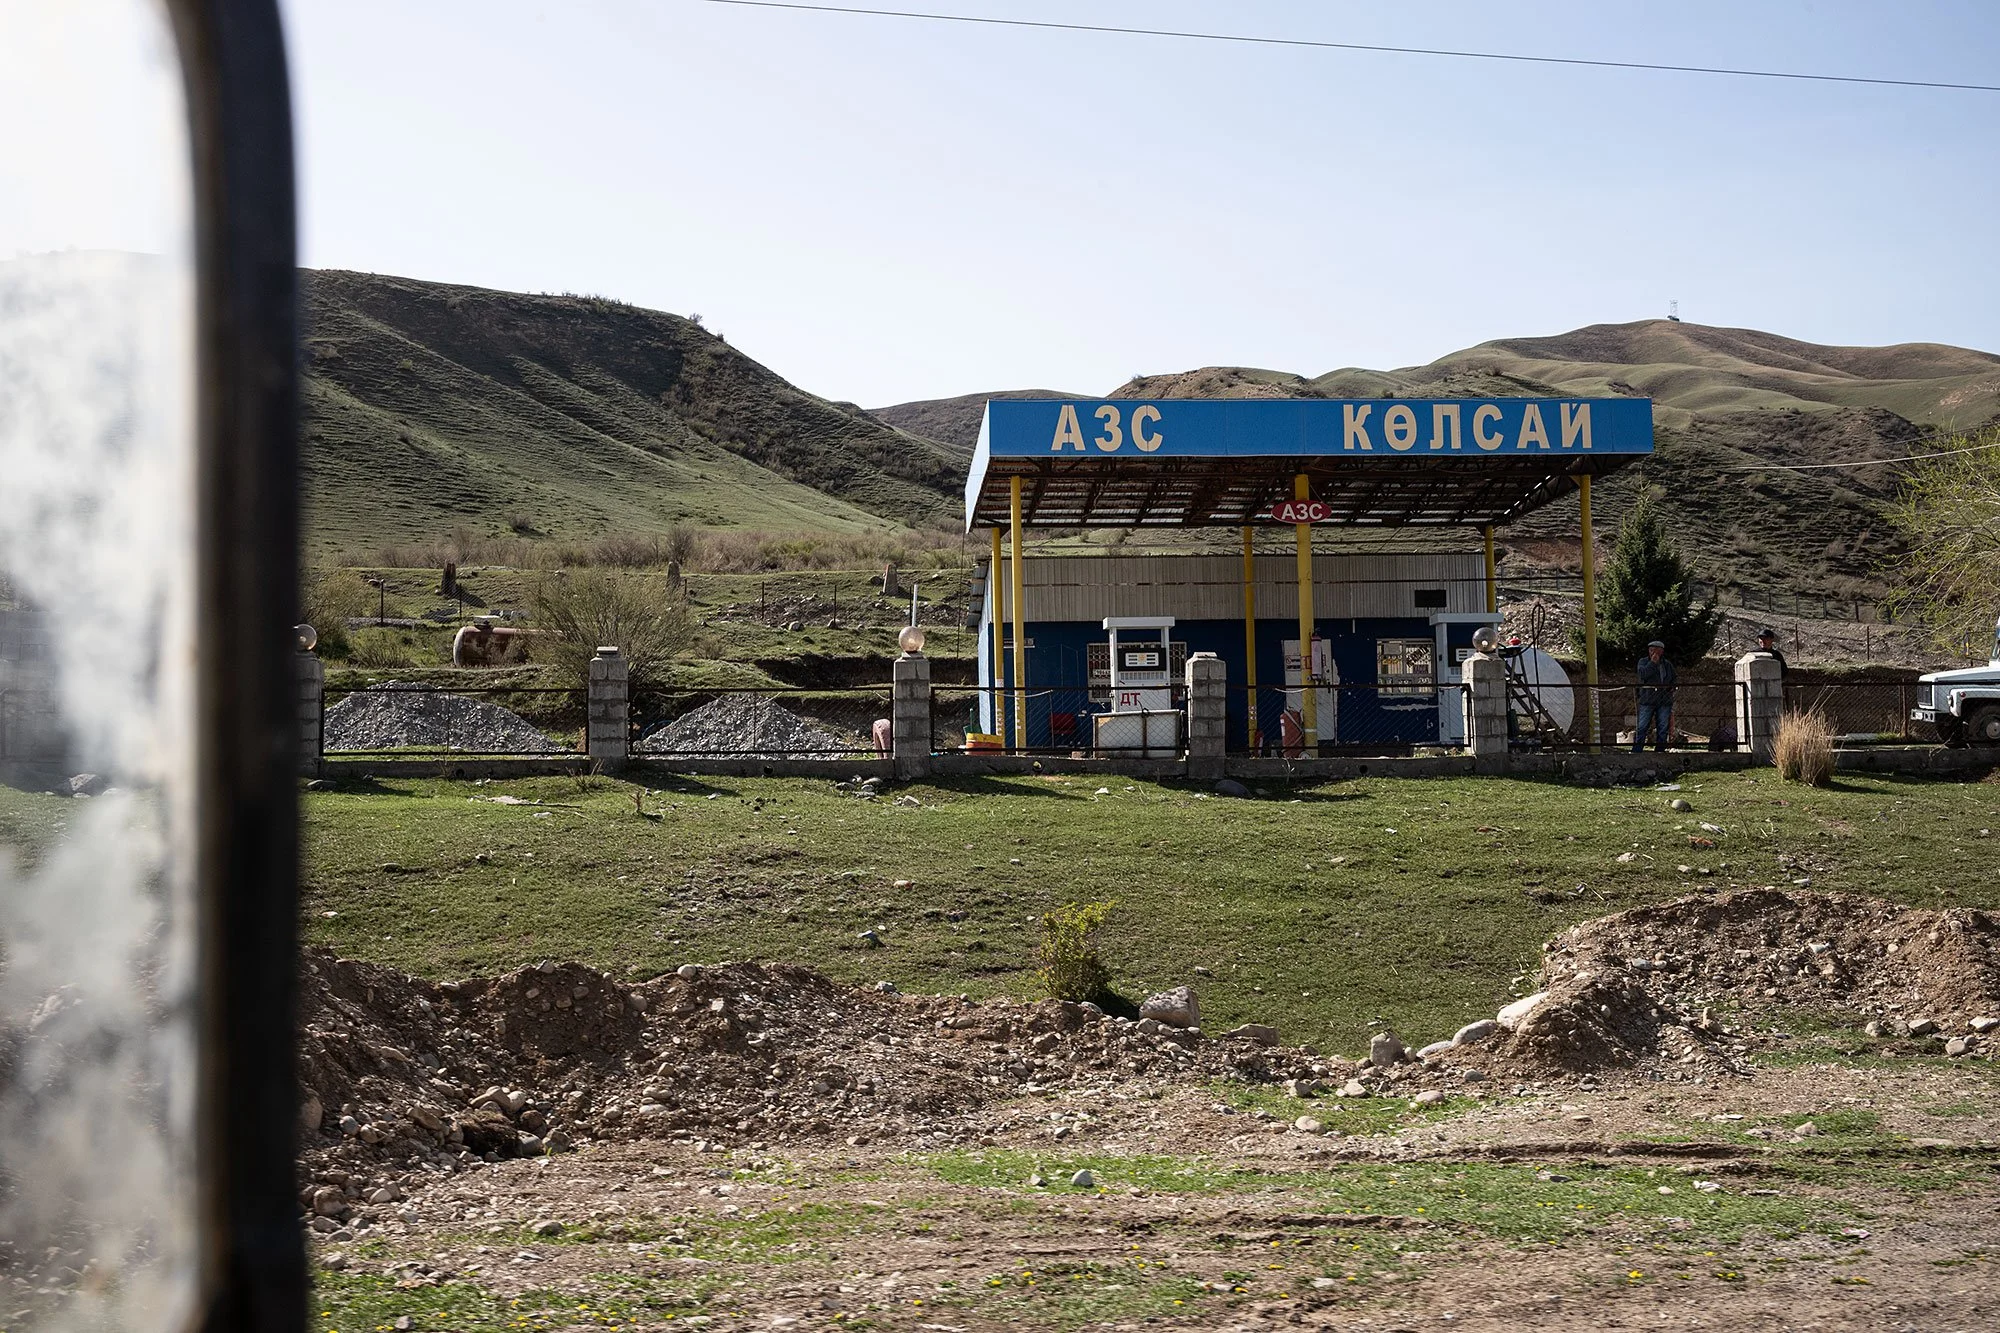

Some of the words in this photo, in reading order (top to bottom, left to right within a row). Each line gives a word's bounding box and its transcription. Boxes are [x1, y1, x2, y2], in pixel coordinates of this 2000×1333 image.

[1051, 404, 1164, 452] АЗС
[1343, 403, 1592, 451] КӨЛСАЙ
[1281, 503, 1323, 520] АЗС
[1120, 692, 1141, 706] ДТ
